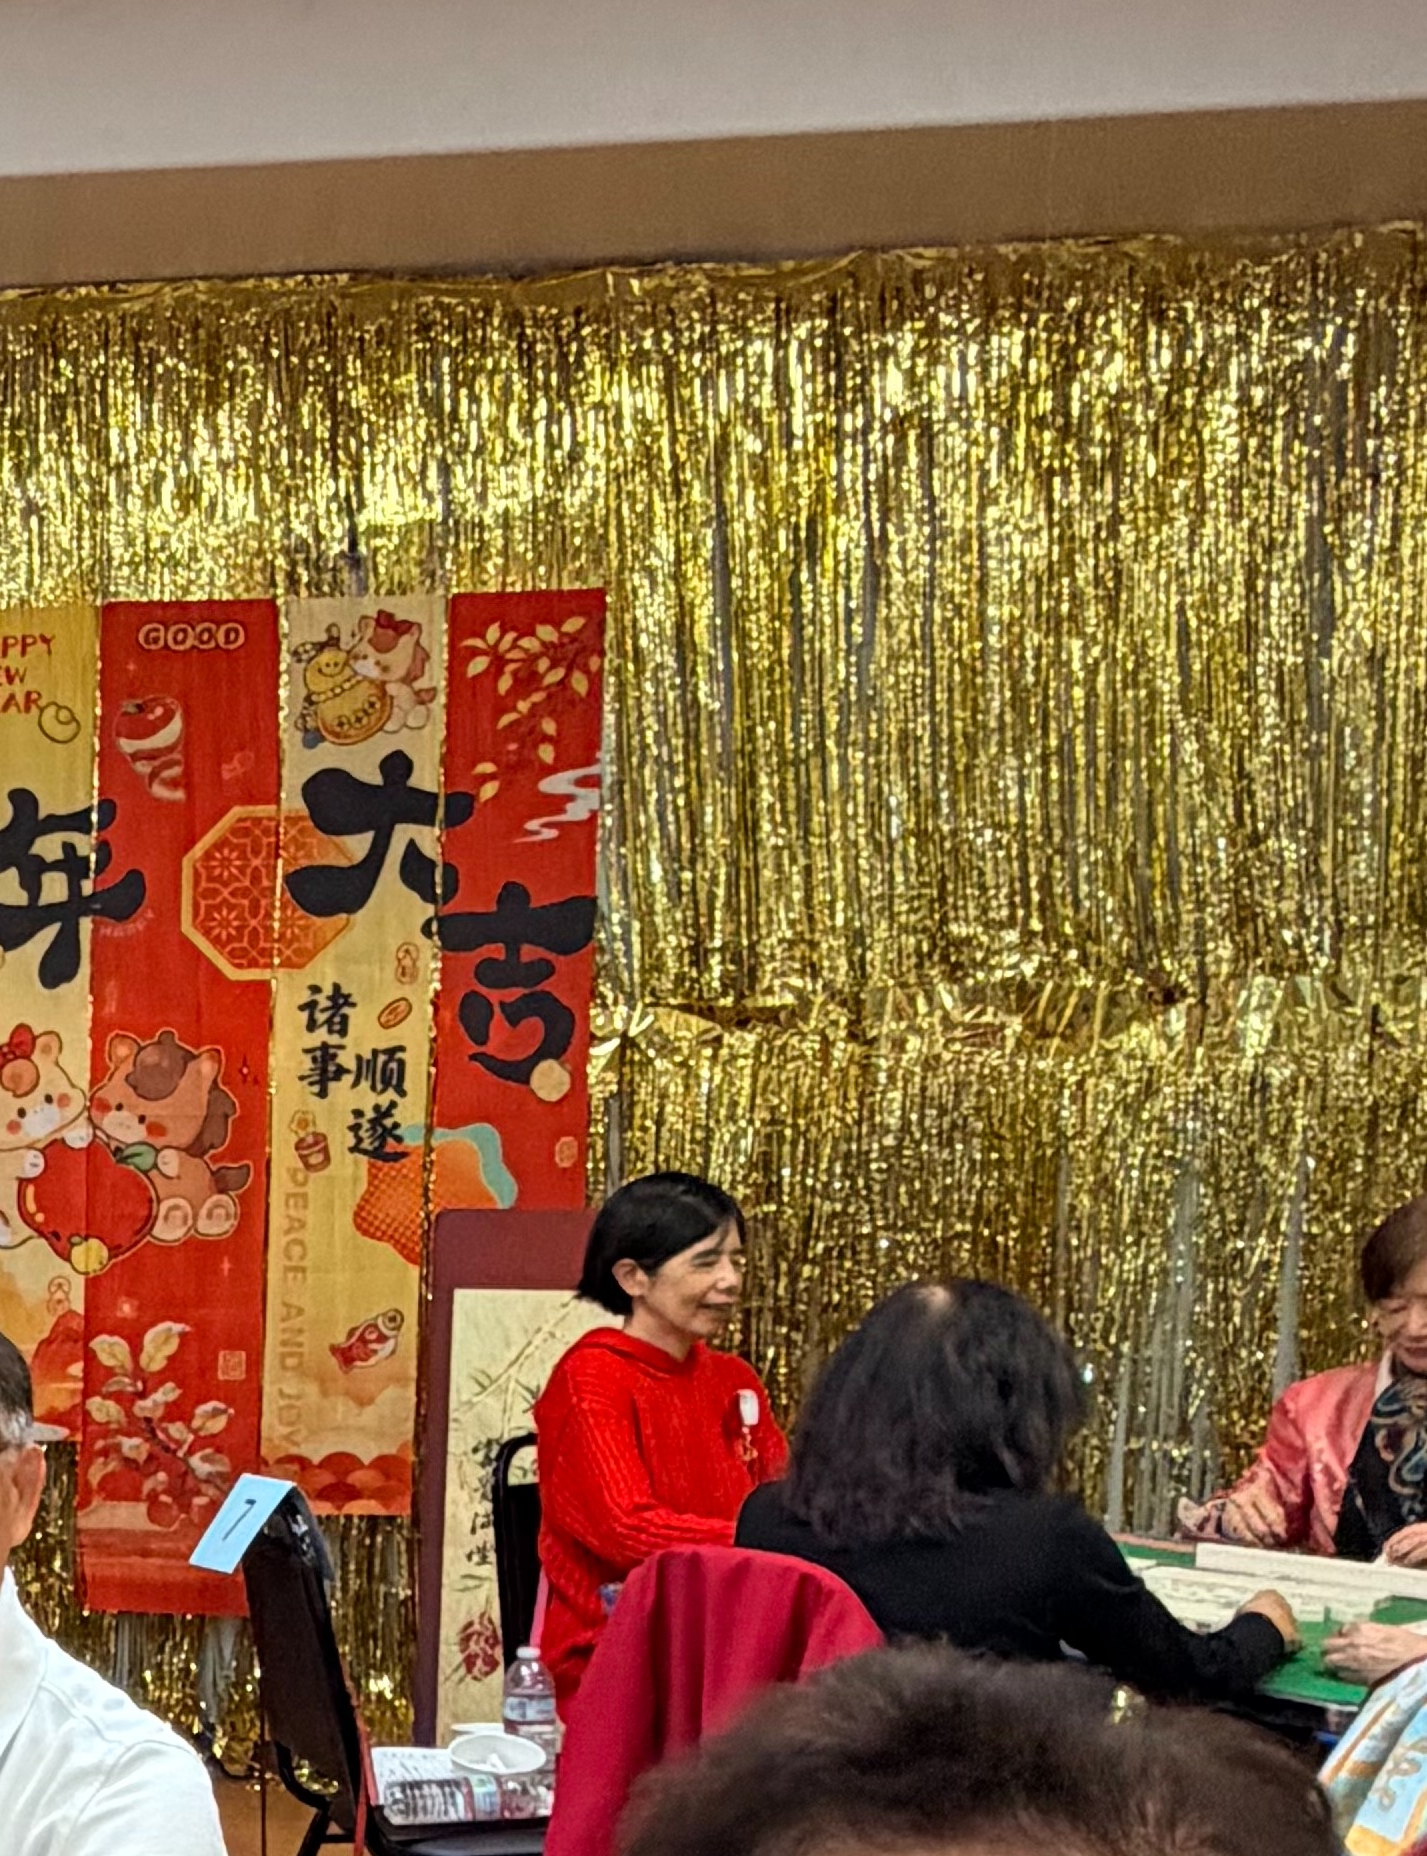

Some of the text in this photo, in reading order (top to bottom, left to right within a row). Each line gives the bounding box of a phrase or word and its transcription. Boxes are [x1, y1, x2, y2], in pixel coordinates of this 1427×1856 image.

[138, 622, 246, 650] GOOD
[297, 981, 357, 1100] 诸事
[347, 1045, 410, 1163] 顺遂
[276, 1167, 310, 1449] PEACE AND JOY
